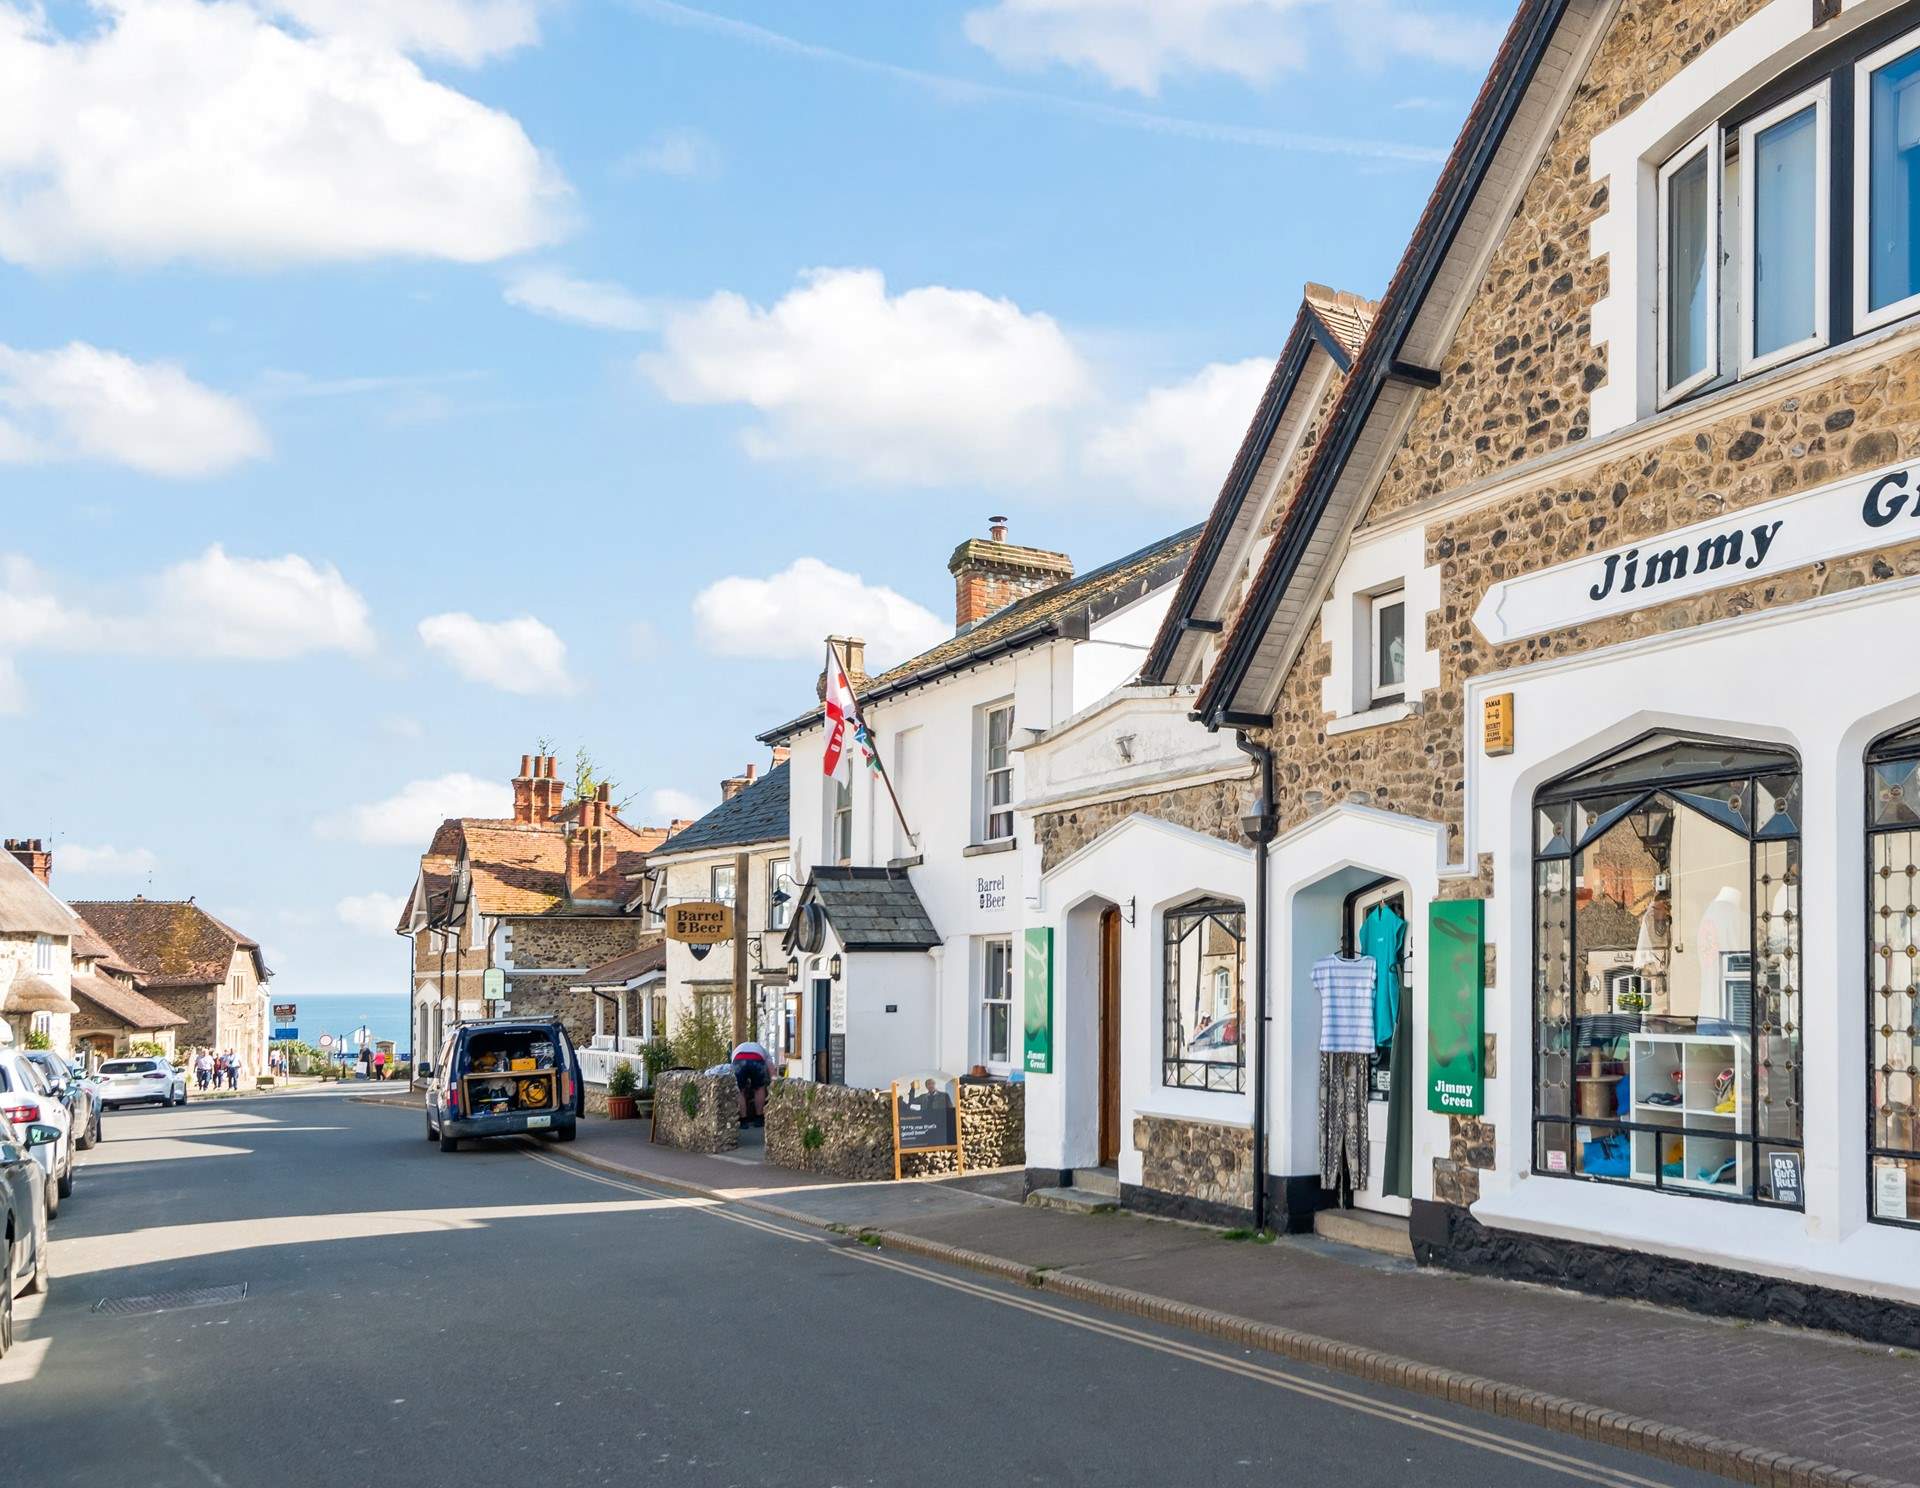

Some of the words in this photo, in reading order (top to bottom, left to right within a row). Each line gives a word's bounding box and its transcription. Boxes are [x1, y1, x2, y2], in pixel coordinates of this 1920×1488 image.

[1589, 520, 1784, 601] Jimmy
[1862, 470, 1920, 528] G
[977, 874, 1005, 893] Barrel
[985, 893, 1006, 909] Beer
[677, 910, 724, 921] Barrel
[689, 922, 723, 933] Beer
[1434, 1080, 1473, 1097] Jimmy
[1441, 1094, 1473, 1108] Green
[1775, 1158, 1793, 1169] OLD
[1774, 1168, 1796, 1178] GUYS
[1776, 1177, 1797, 1188] RULE
